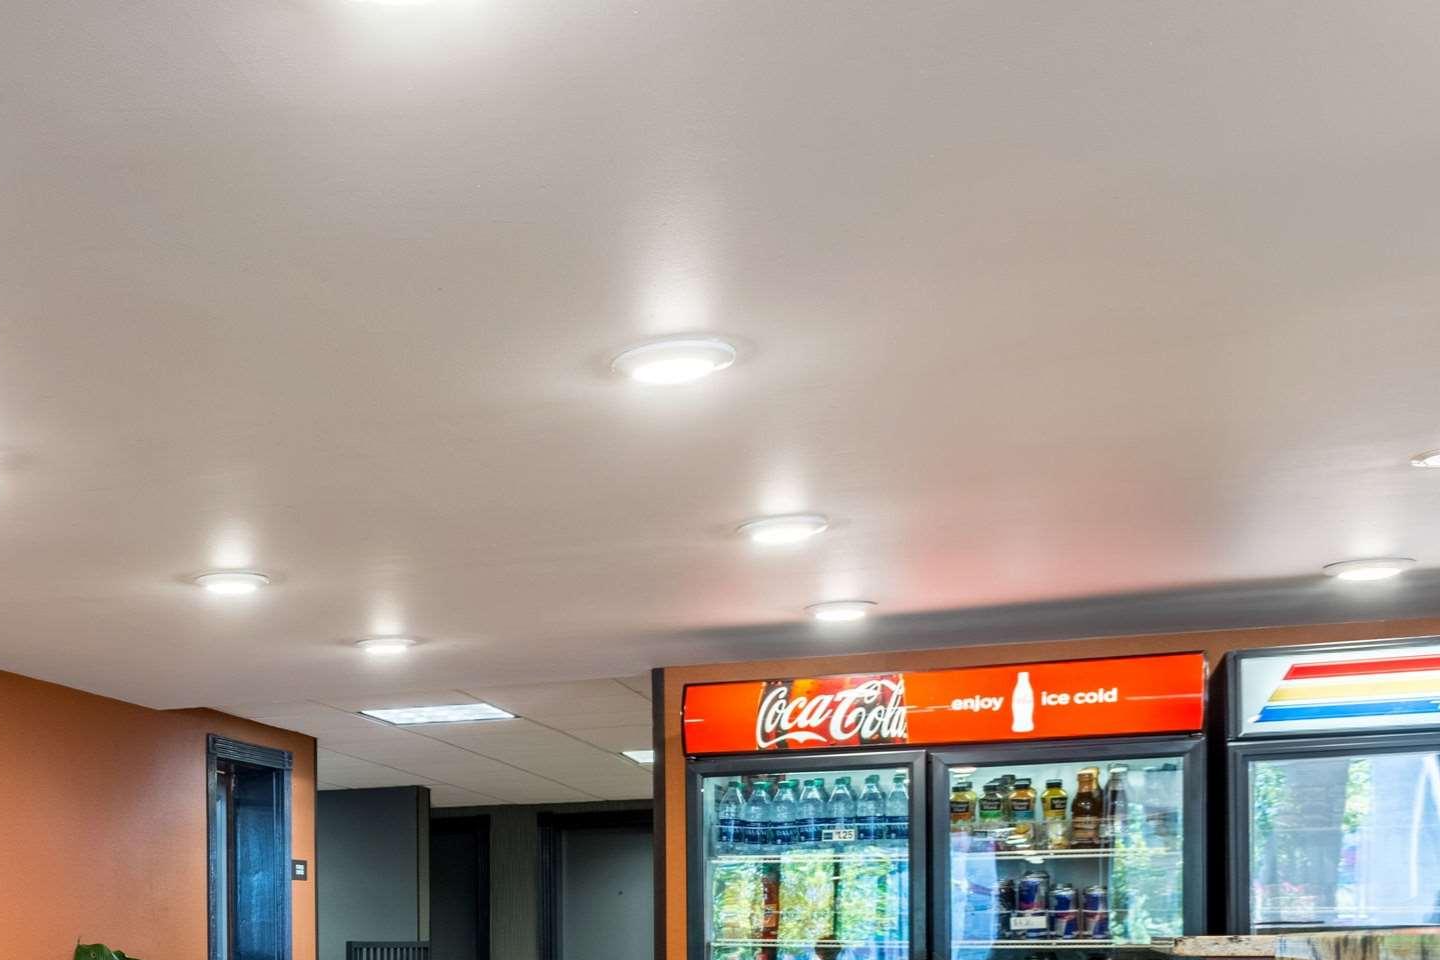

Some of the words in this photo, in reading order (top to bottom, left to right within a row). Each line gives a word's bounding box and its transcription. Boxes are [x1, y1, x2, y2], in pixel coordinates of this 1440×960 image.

[951, 695, 1004, 712] enjoy
[1041, 691, 1070, 706] ice
[1073, 688, 1118, 704] cold
[756, 679, 907, 748] Coca-Cola
